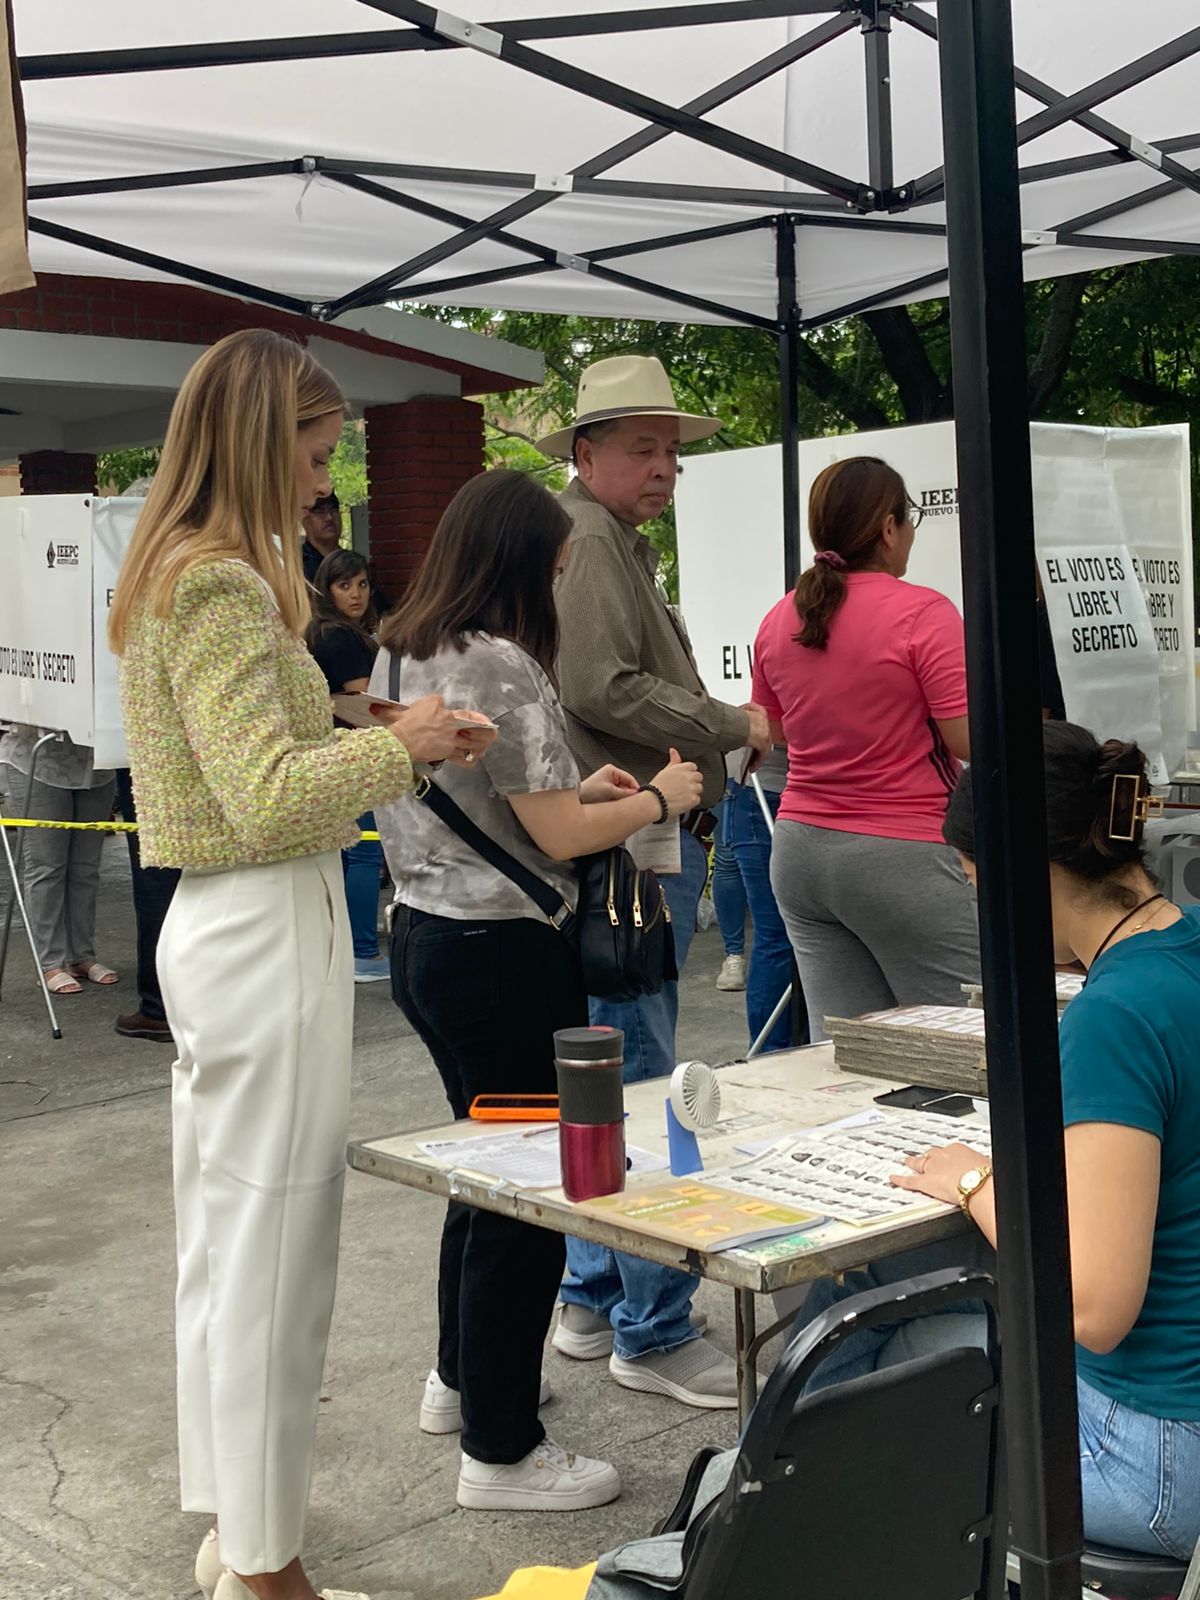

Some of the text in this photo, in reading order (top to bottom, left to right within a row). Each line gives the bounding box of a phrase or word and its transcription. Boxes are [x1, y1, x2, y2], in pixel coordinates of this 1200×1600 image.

[921, 488, 959, 507] IEE
[57, 544, 79, 558] IEEPC
[1046, 557, 1125, 583] EL VOTO ES
[1143, 559, 1167, 584] VOTO
[1168, 560, 1180, 584] ES
[1067, 590, 1122, 617] LIBRE Y
[1148, 593, 1174, 618] BRE Y
[1072, 623, 1138, 653] SECRETO
[1153, 627, 1179, 652] CRETO
[36, 651, 41, 680] Y
[43, 652, 76, 684] SECRETO
[722, 645, 743, 680] EL
